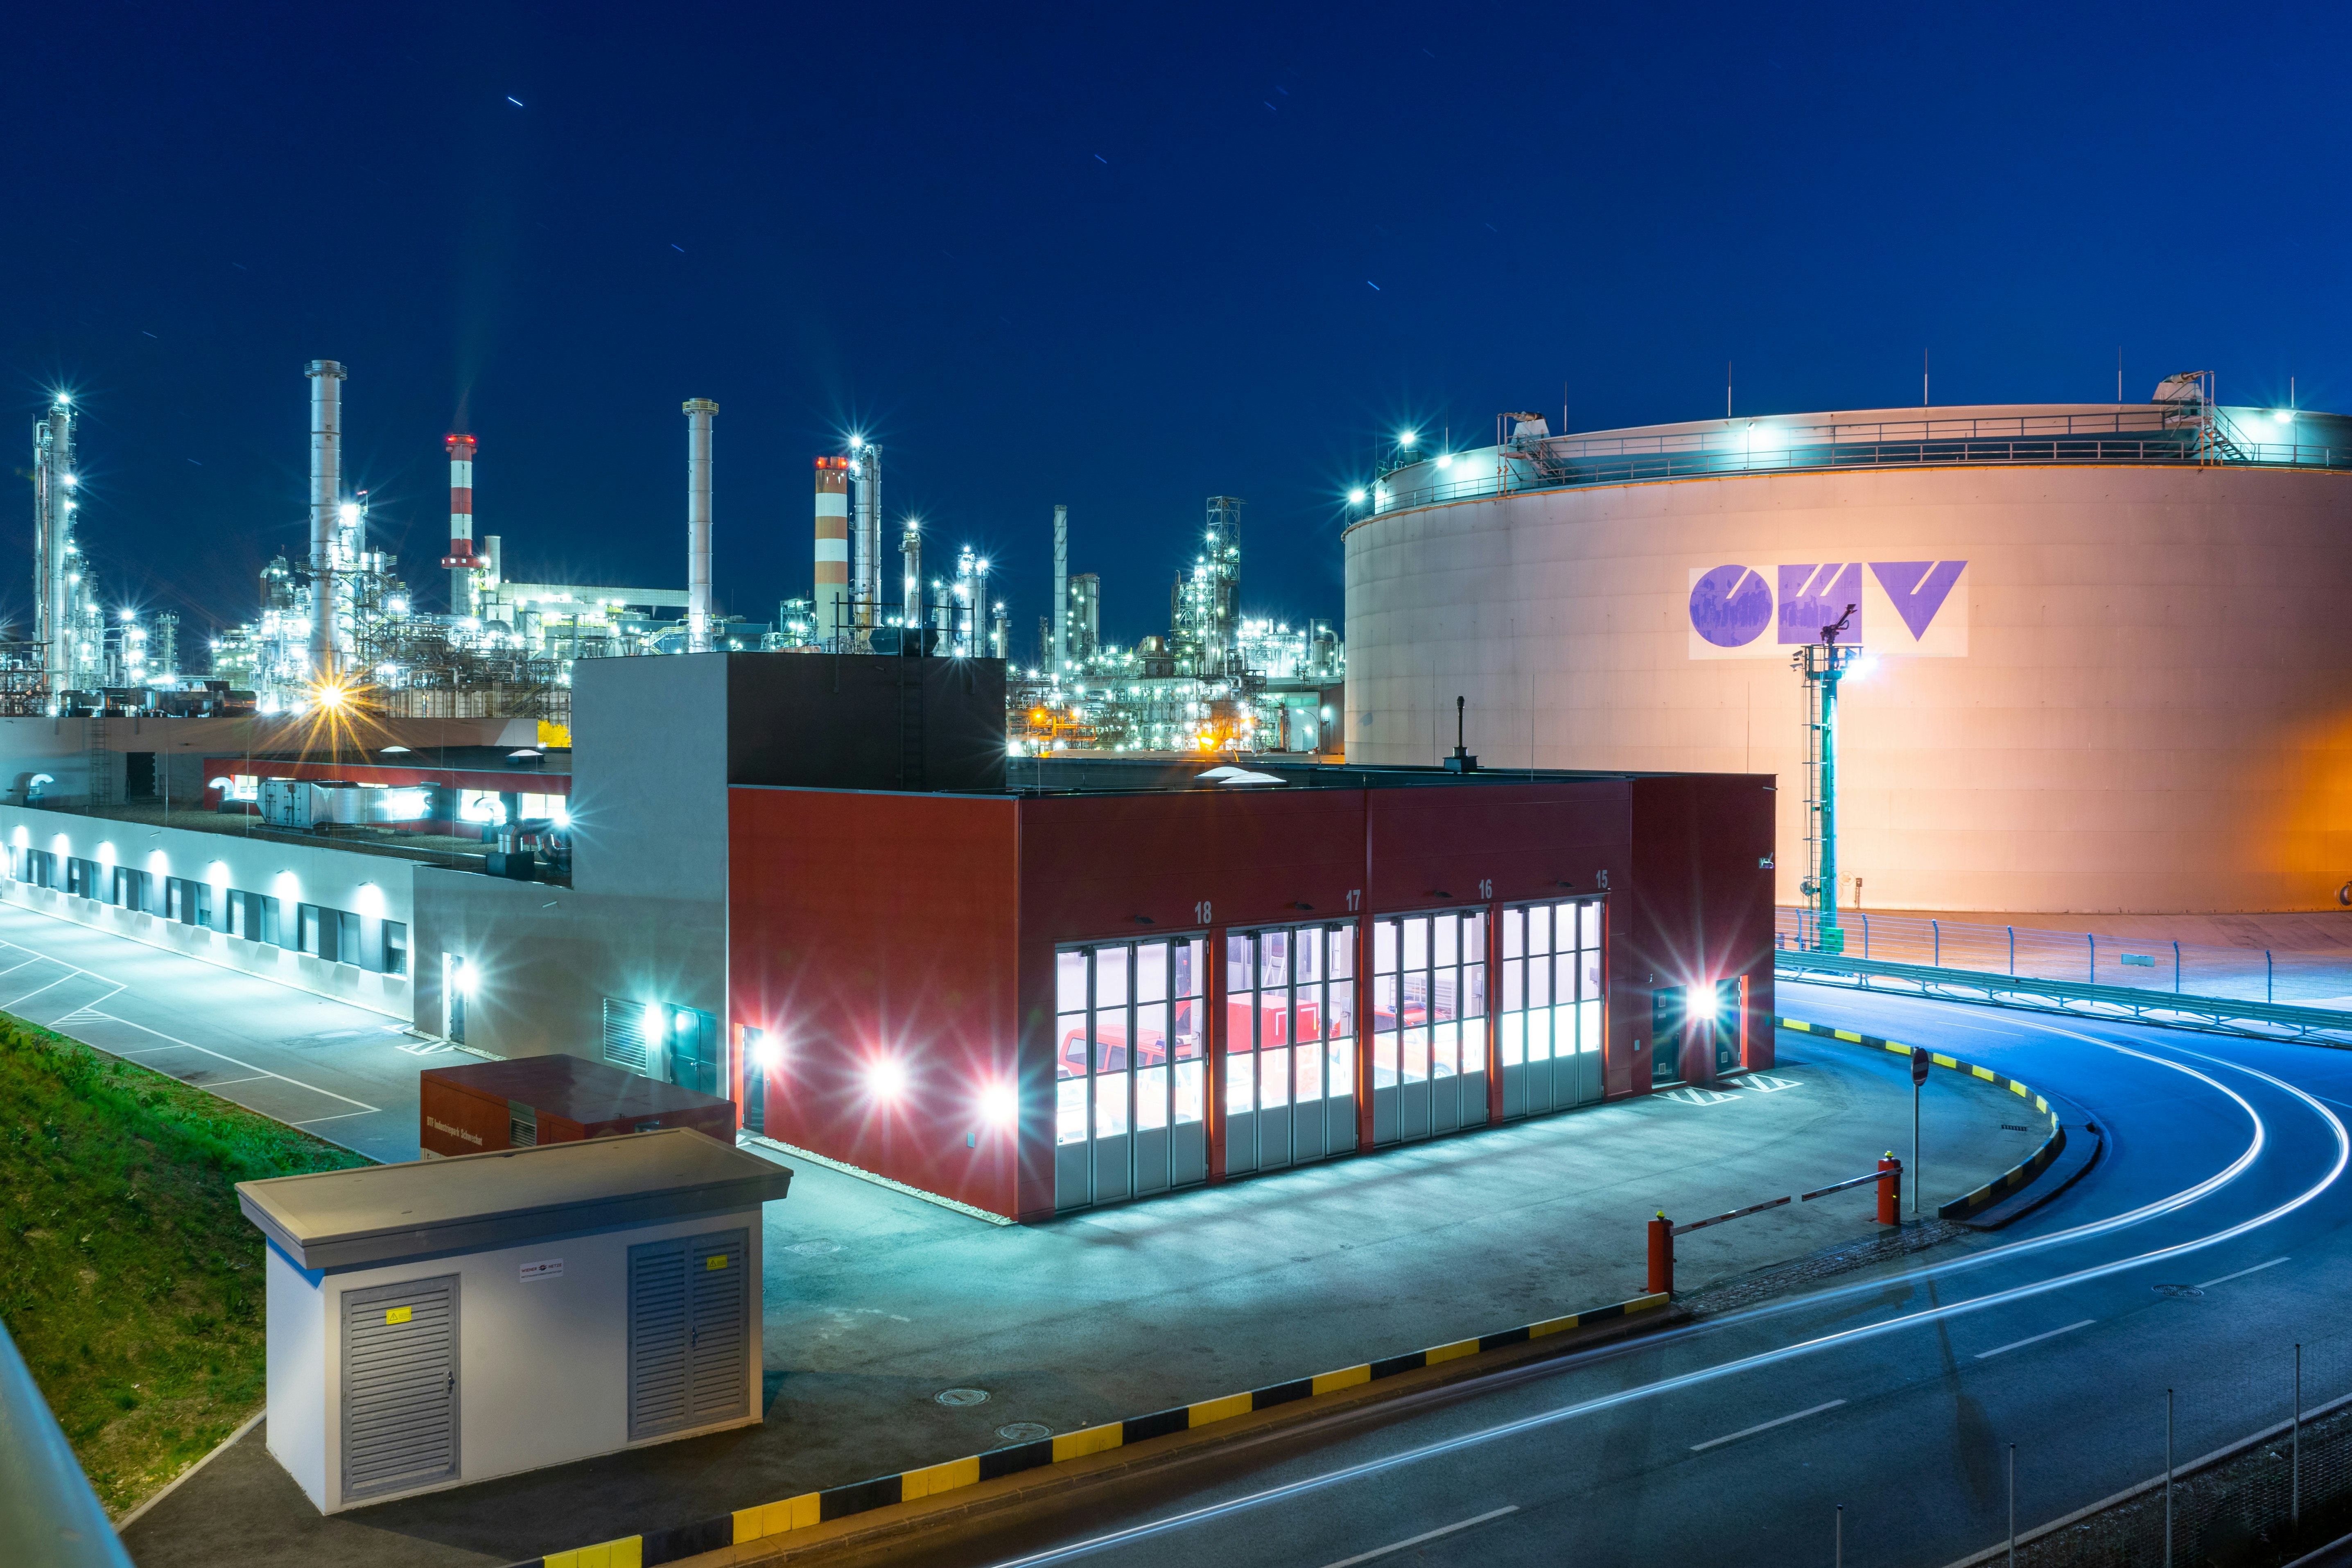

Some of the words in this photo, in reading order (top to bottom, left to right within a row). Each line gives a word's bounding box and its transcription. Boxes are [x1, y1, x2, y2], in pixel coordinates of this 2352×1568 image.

[1689, 560, 1968, 648] OMV
[1479, 879, 1492, 899] 16
[1596, 870, 1608, 888] 15
[1346, 889, 1360, 911] 17
[1195, 901, 1211, 924] 18
[434, 1118, 459, 1137] Industriepark
[461, 1128, 482, 1146] Schwechat
